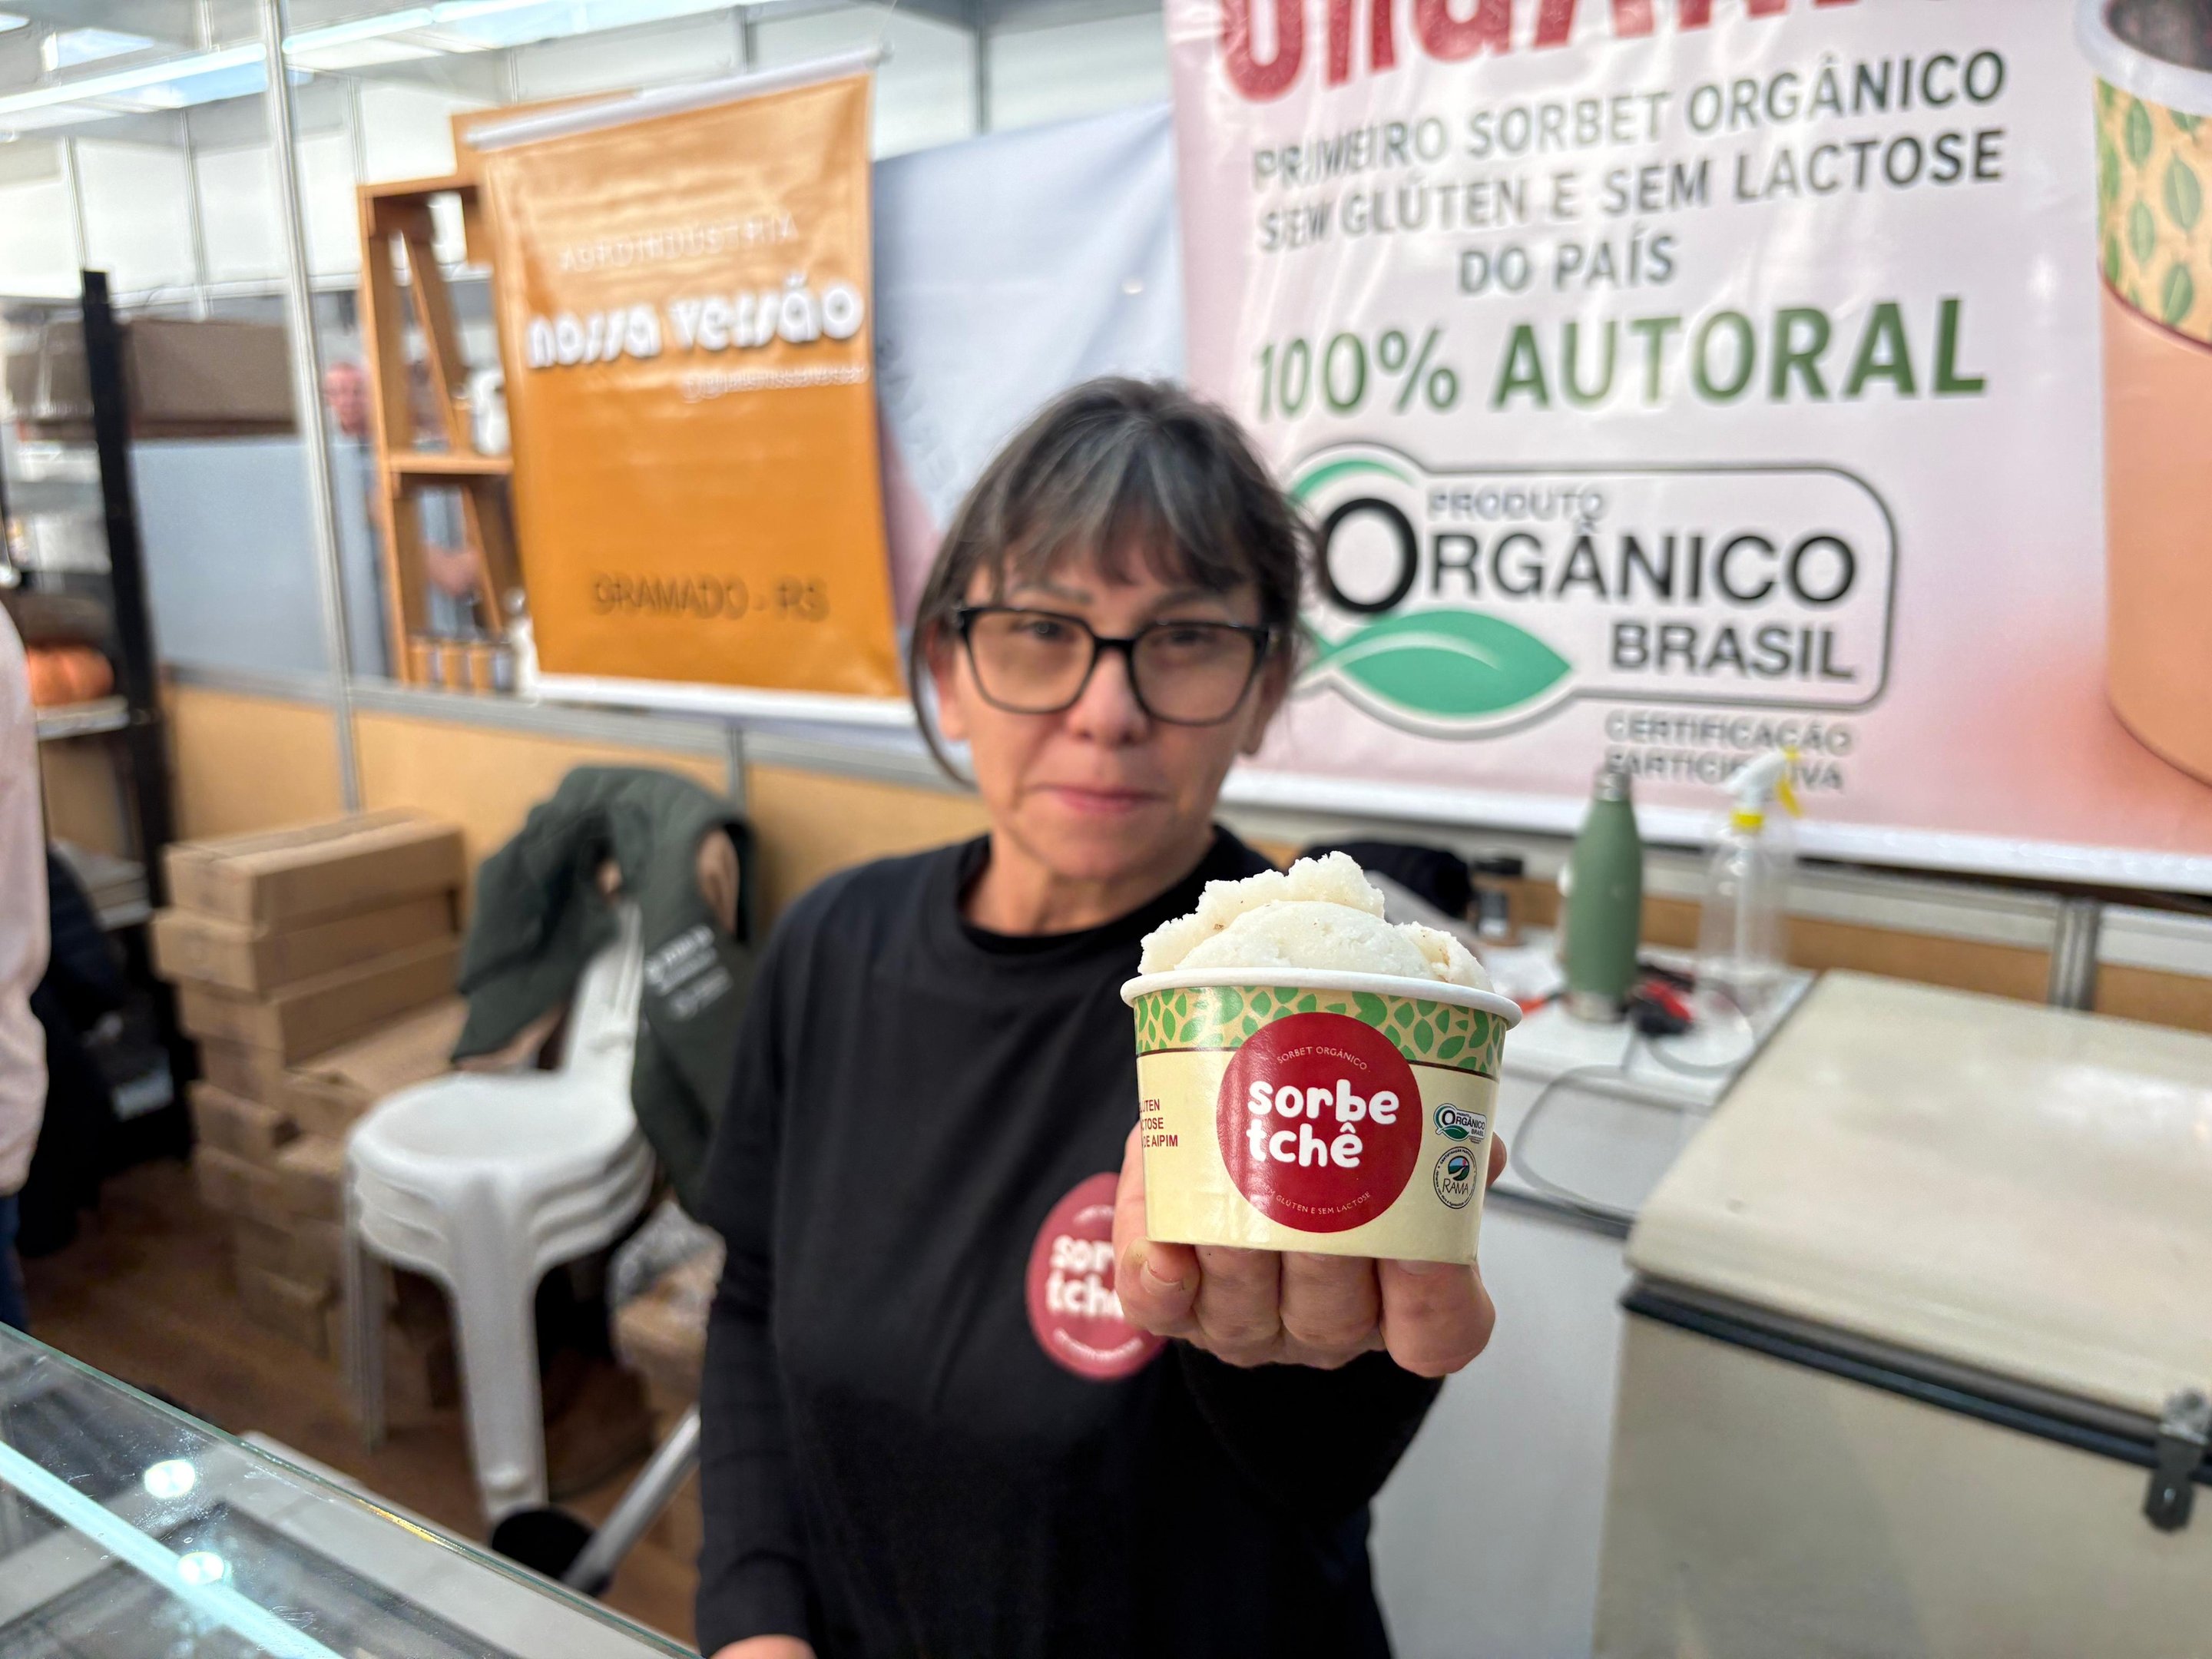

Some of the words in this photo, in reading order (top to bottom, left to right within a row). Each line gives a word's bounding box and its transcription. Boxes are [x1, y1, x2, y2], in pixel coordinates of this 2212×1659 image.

[1253, 118, 1447, 190] PRIMEIRO
[1469, 91, 1670, 157] SORBET
[1689, 51, 2006, 134] ORGÂNICO
[1258, 200, 1331, 252] SEM
[1341, 173, 1525, 236] GLÚTEN
[1550, 171, 1579, 218] E
[1604, 158, 1710, 216] SEM
[1734, 129, 2006, 201] LACTOSE
[1460, 245, 1530, 293] DO
[1551, 227, 1676, 291] PAÍS
[528, 308, 661, 367] nossa
[669, 273, 863, 351] versão
[1257, 324, 1457, 422] 100%
[1492, 298, 1987, 412] AUTORAL
[1427, 485, 1605, 521] PRODUTO
[1322, 498, 1856, 615] ORGÂNICO
[591, 575, 749, 618] GRAMADO
[775, 576, 830, 623] RS
[1611, 622, 1855, 680] BRASIL
[1277, 1046, 1313, 1064] SORBET
[1316, 1046, 1367, 1070] ORGÂNICO
[1247, 1079, 1399, 1124] sorbe
[1442, 1110, 1485, 1130] ORGÂNICO
[1151, 1134, 1178, 1147] AIPIM
[1246, 1111, 1363, 1168] tchê
[1276, 1194, 1308, 1212] GLÚTEN
[1318, 1207, 1334, 1215] SEM
[1336, 1191, 1371, 1213] LACTOSE
[1442, 1178, 1469, 1194] RAMA
